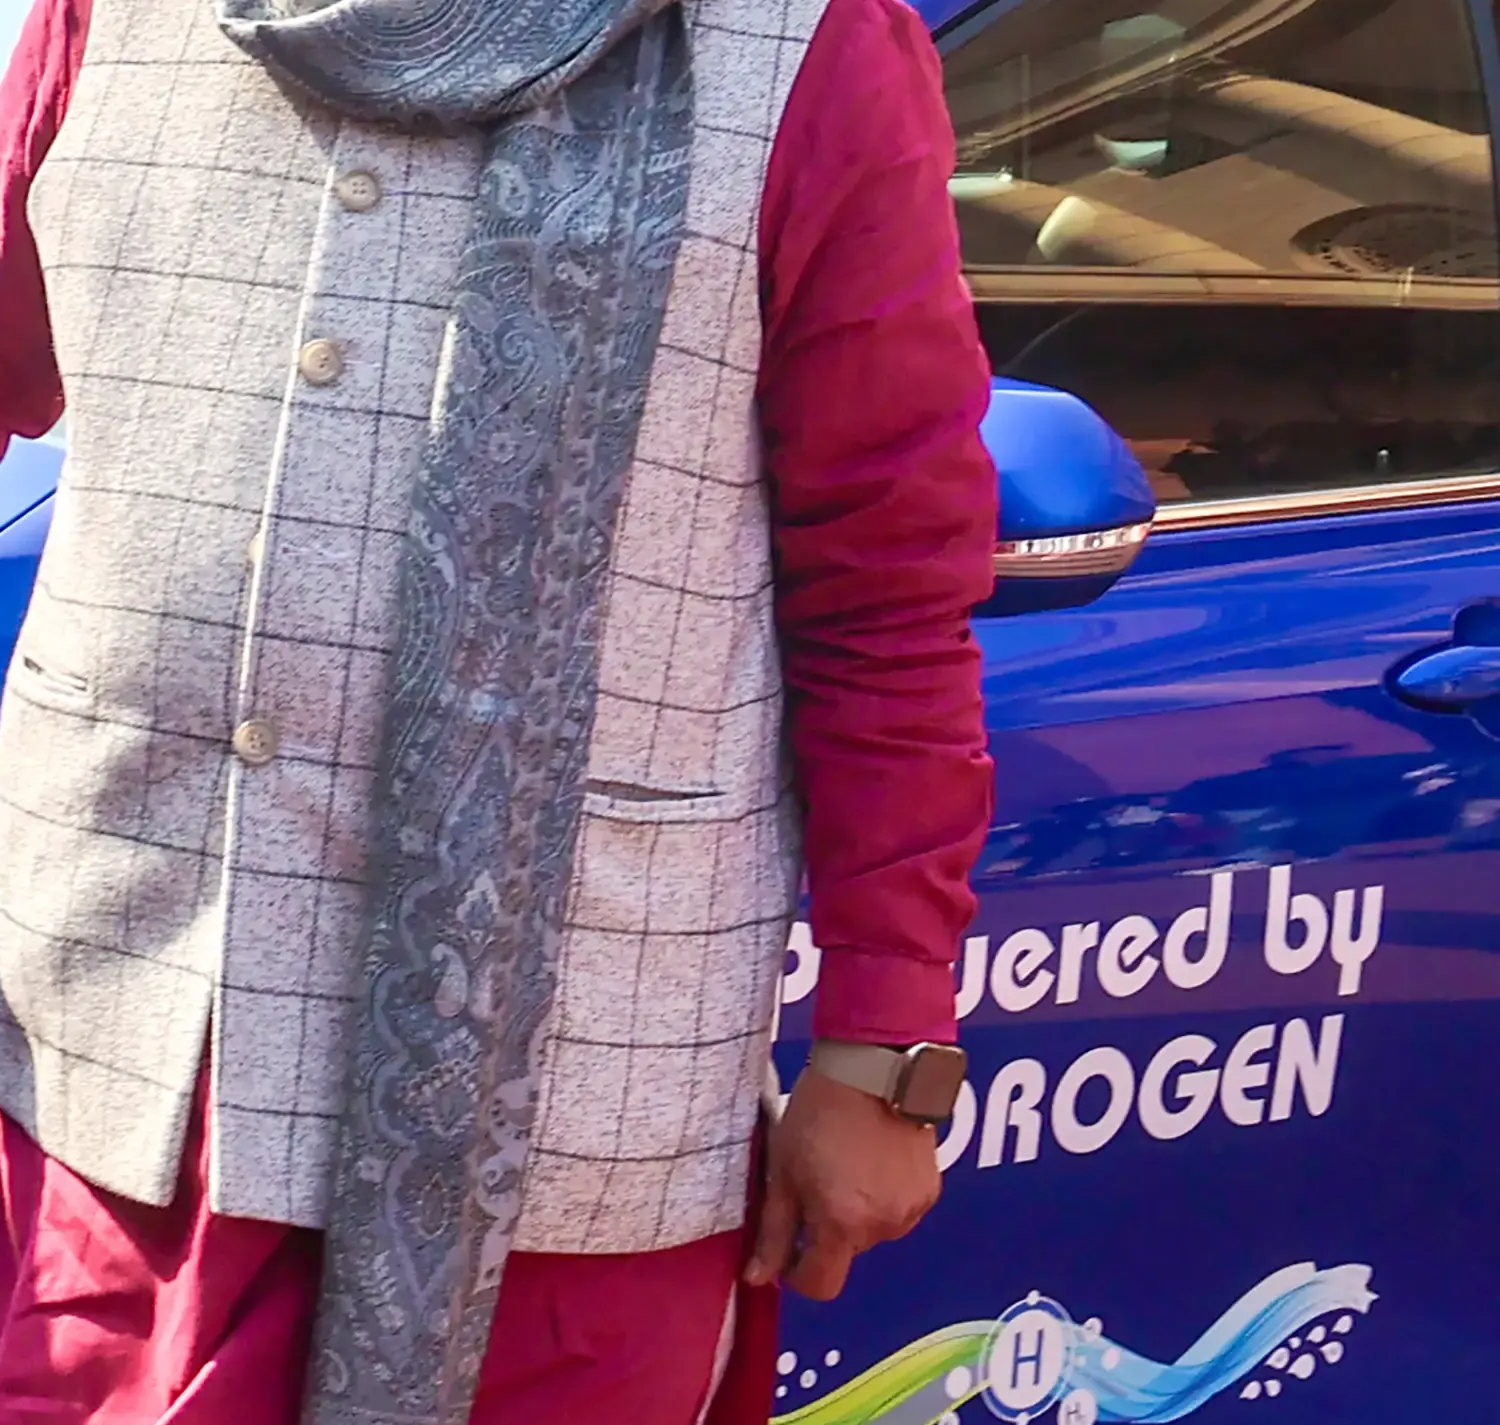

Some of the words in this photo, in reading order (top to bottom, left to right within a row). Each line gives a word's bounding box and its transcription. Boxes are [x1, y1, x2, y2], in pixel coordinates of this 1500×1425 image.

[770, 872, 1233, 1043] Pered
[1264, 864, 1385, 996] by
[764, 1013, 1344, 1173] ROGEN
